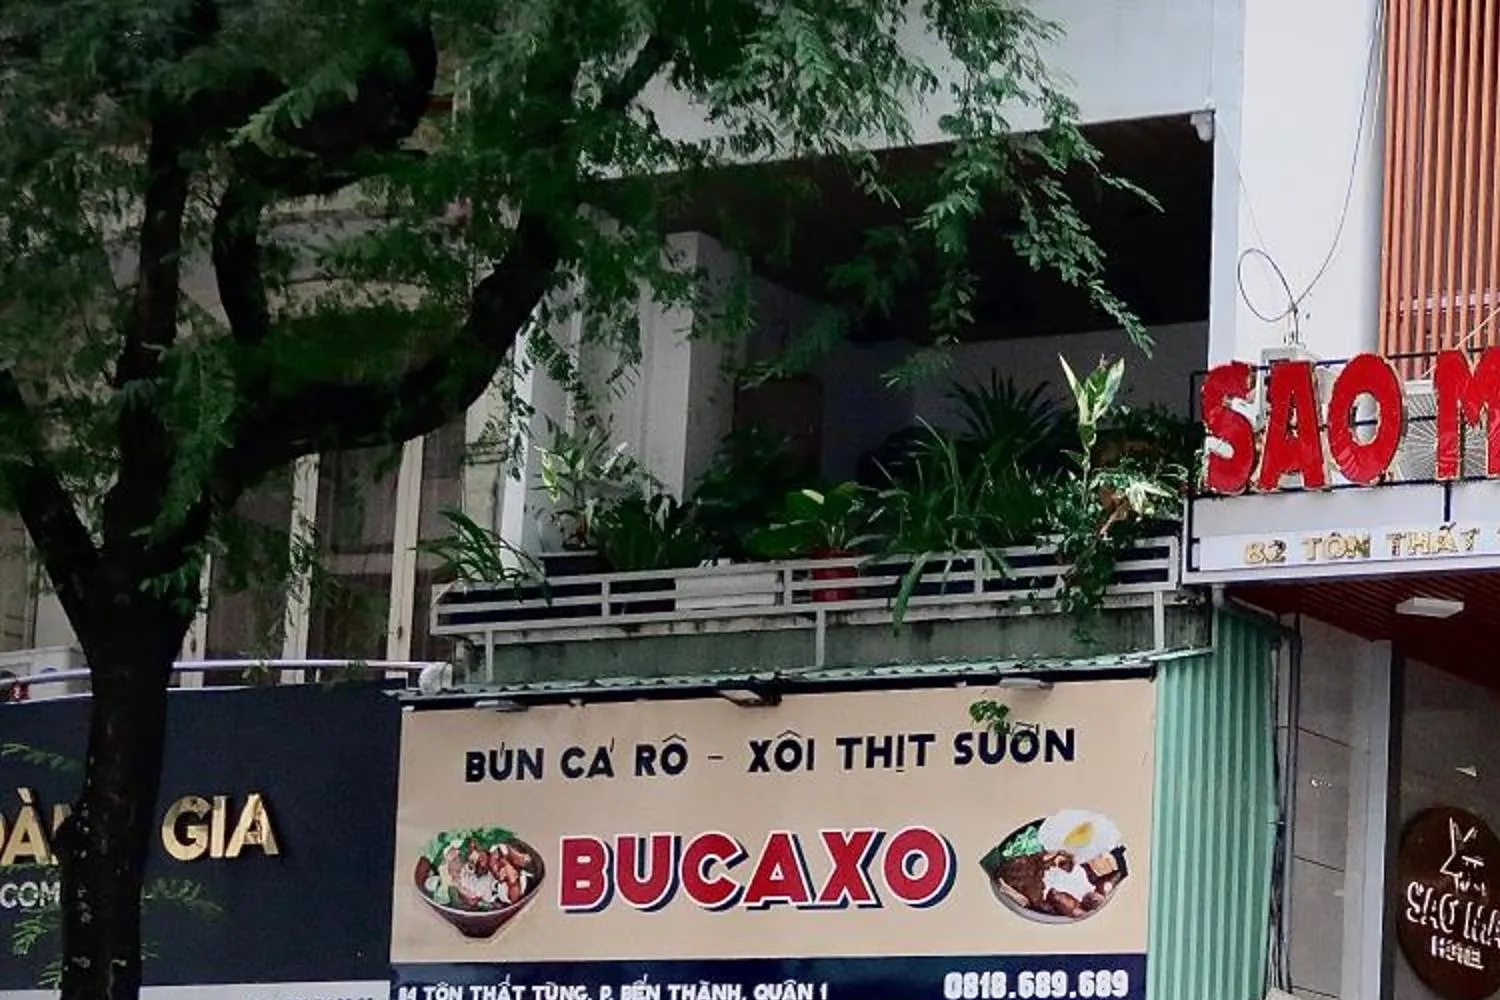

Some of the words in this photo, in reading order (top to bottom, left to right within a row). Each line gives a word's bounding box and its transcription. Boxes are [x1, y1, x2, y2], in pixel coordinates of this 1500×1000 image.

[1202, 353, 1403, 494] SAO
[465, 741, 545, 783] BÚN
[560, 737, 616, 779] CÁ
[634, 733, 689, 777] RÔ
[747, 729, 815, 773] XÔI
[836, 733, 936, 773] THỊT
[161, 792, 279, 862] GIA
[558, 828, 957, 913] BUCAXO
[820, 983, 827, 1000] 1
[944, 969, 1130, 1000] 0818.689.689
